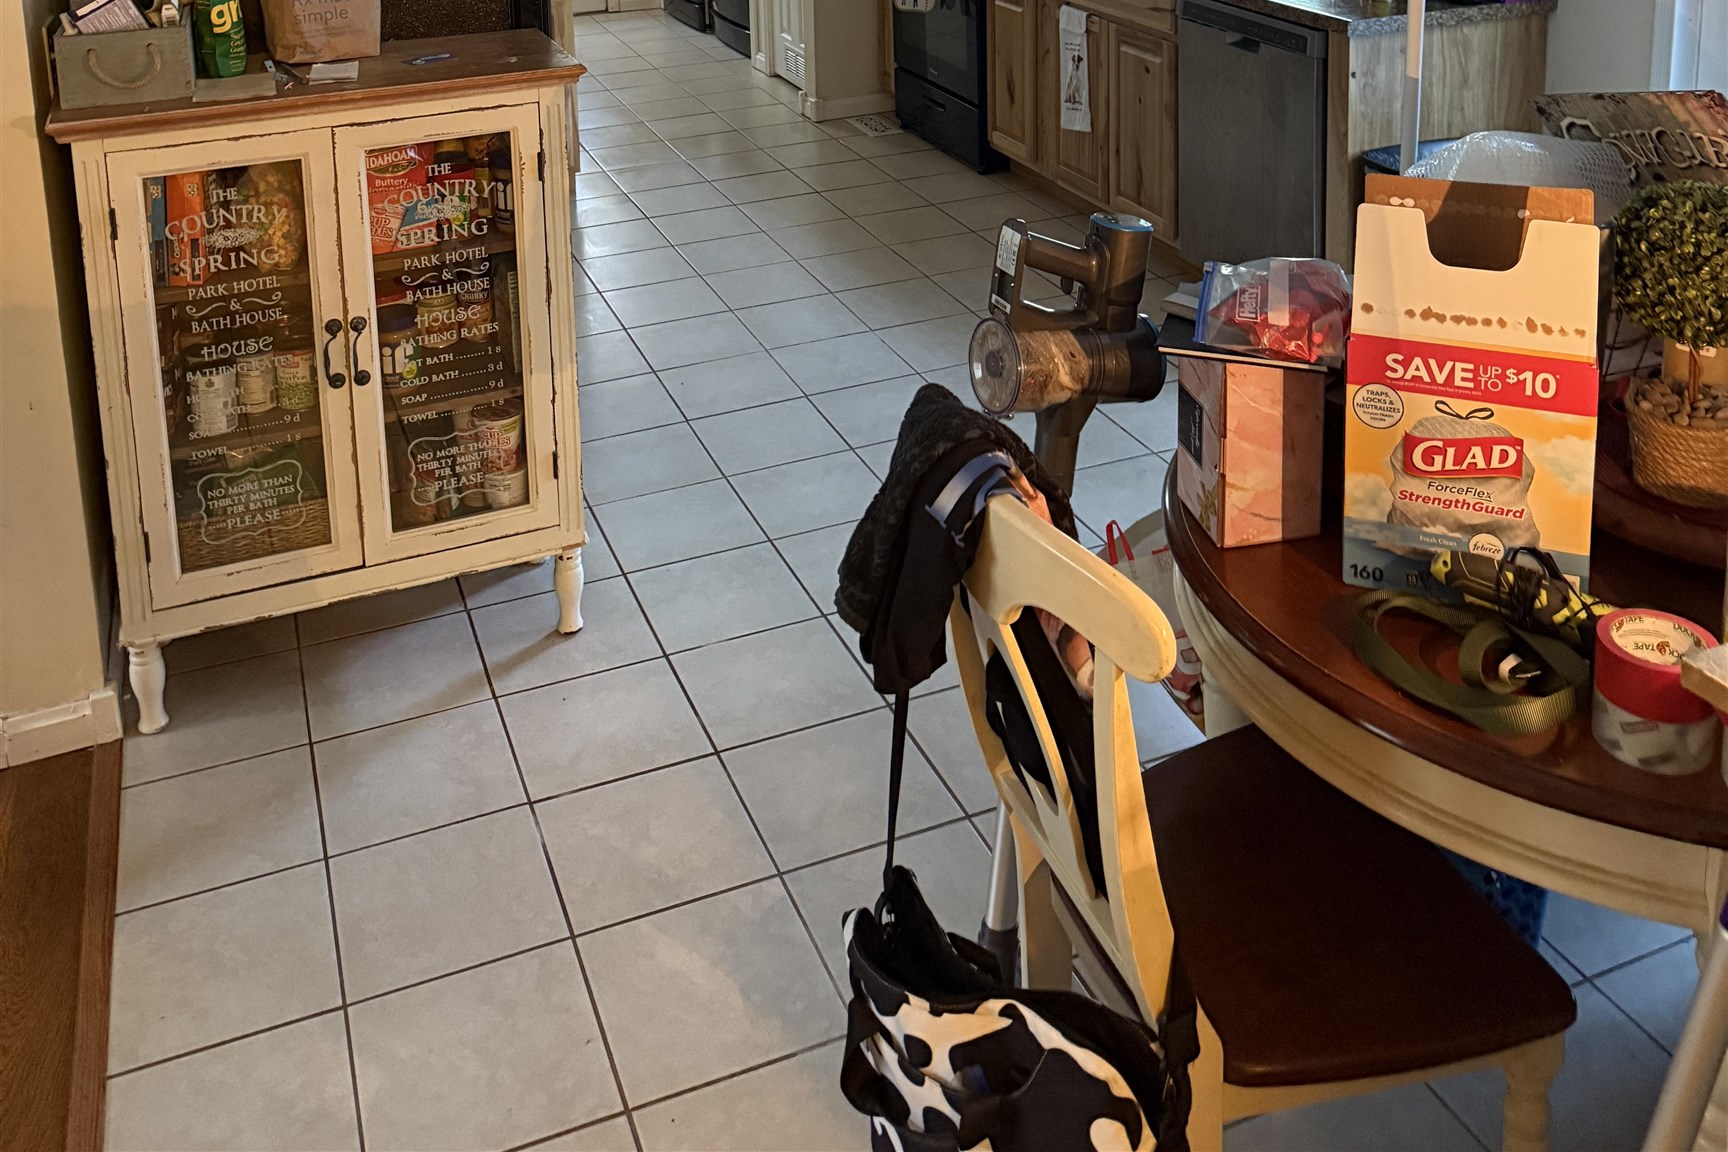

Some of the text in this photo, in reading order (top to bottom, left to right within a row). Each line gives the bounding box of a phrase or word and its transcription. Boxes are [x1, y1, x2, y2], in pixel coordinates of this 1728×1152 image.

[293, 6, 350, 26] simple
[425, 162, 452, 176] THE
[375, 177, 409, 188] Buttery
[383, 178, 497, 208] COUNTRY
[211, 187, 238, 203] THE
[165, 204, 289, 241] COUNTRY
[396, 218, 488, 248] SPRING
[180, 246, 280, 277] SPRING
[404, 247, 489, 271] PARK HOTEL
[442, 268, 453, 280] &
[188, 276, 281, 301] PARK HOTEL
[406, 285, 443, 302] BATH
[447, 277, 490, 295] HOUSE
[229, 298, 242, 311] &
[1239, 285, 1261, 318] Hefty
[191, 307, 284, 334] BATH HOUSE
[415, 304, 481, 329] HOUSE
[401, 322, 499, 347] BATHING RATES
[201, 335, 274, 362] HOUSE
[186, 354, 293, 383] BATHING RATES
[426, 353, 453, 366] BATH
[400, 361, 503, 389] COLD BATH 3 d
[1384, 353, 1475, 388] SAVE
[1479, 364, 1502, 379] UP
[401, 378, 504, 406] SOAP 9 d
[1366, 389, 1391, 398] TRAPS,
[1477, 377, 1502, 392] TO
[1356, 402, 1401, 414] NEUTRALIZES
[1362, 396, 1387, 405] LOCKS
[188, 413, 301, 441] SOA 9 d
[402, 411, 439, 425] TOWEL
[192, 446, 228, 461] TOWEL
[417, 451, 434, 462] NO
[436, 445, 466, 459] MORE
[417, 448, 500, 472] THIRTY MINUTES
[1412, 440, 1517, 472] GLAD
[434, 461, 482, 478] PER BATH
[207, 474, 293, 499] NO MORE THAN
[434, 472, 485, 492] PLEASE
[1427, 480, 1495, 501] ForceFlex
[207, 485, 296, 509] THIRTY MINUTES
[226, 498, 278, 515] PER BATH
[1398, 489, 1526, 520] StrengthGuard
[226, 509, 281, 528] PLEASE
[1419, 534, 1458, 547] Fresh Clean
[1472, 541, 1503, 556] febreze
[1350, 563, 1384, 583] 160
[1633, 642, 1656, 652] TAPE
